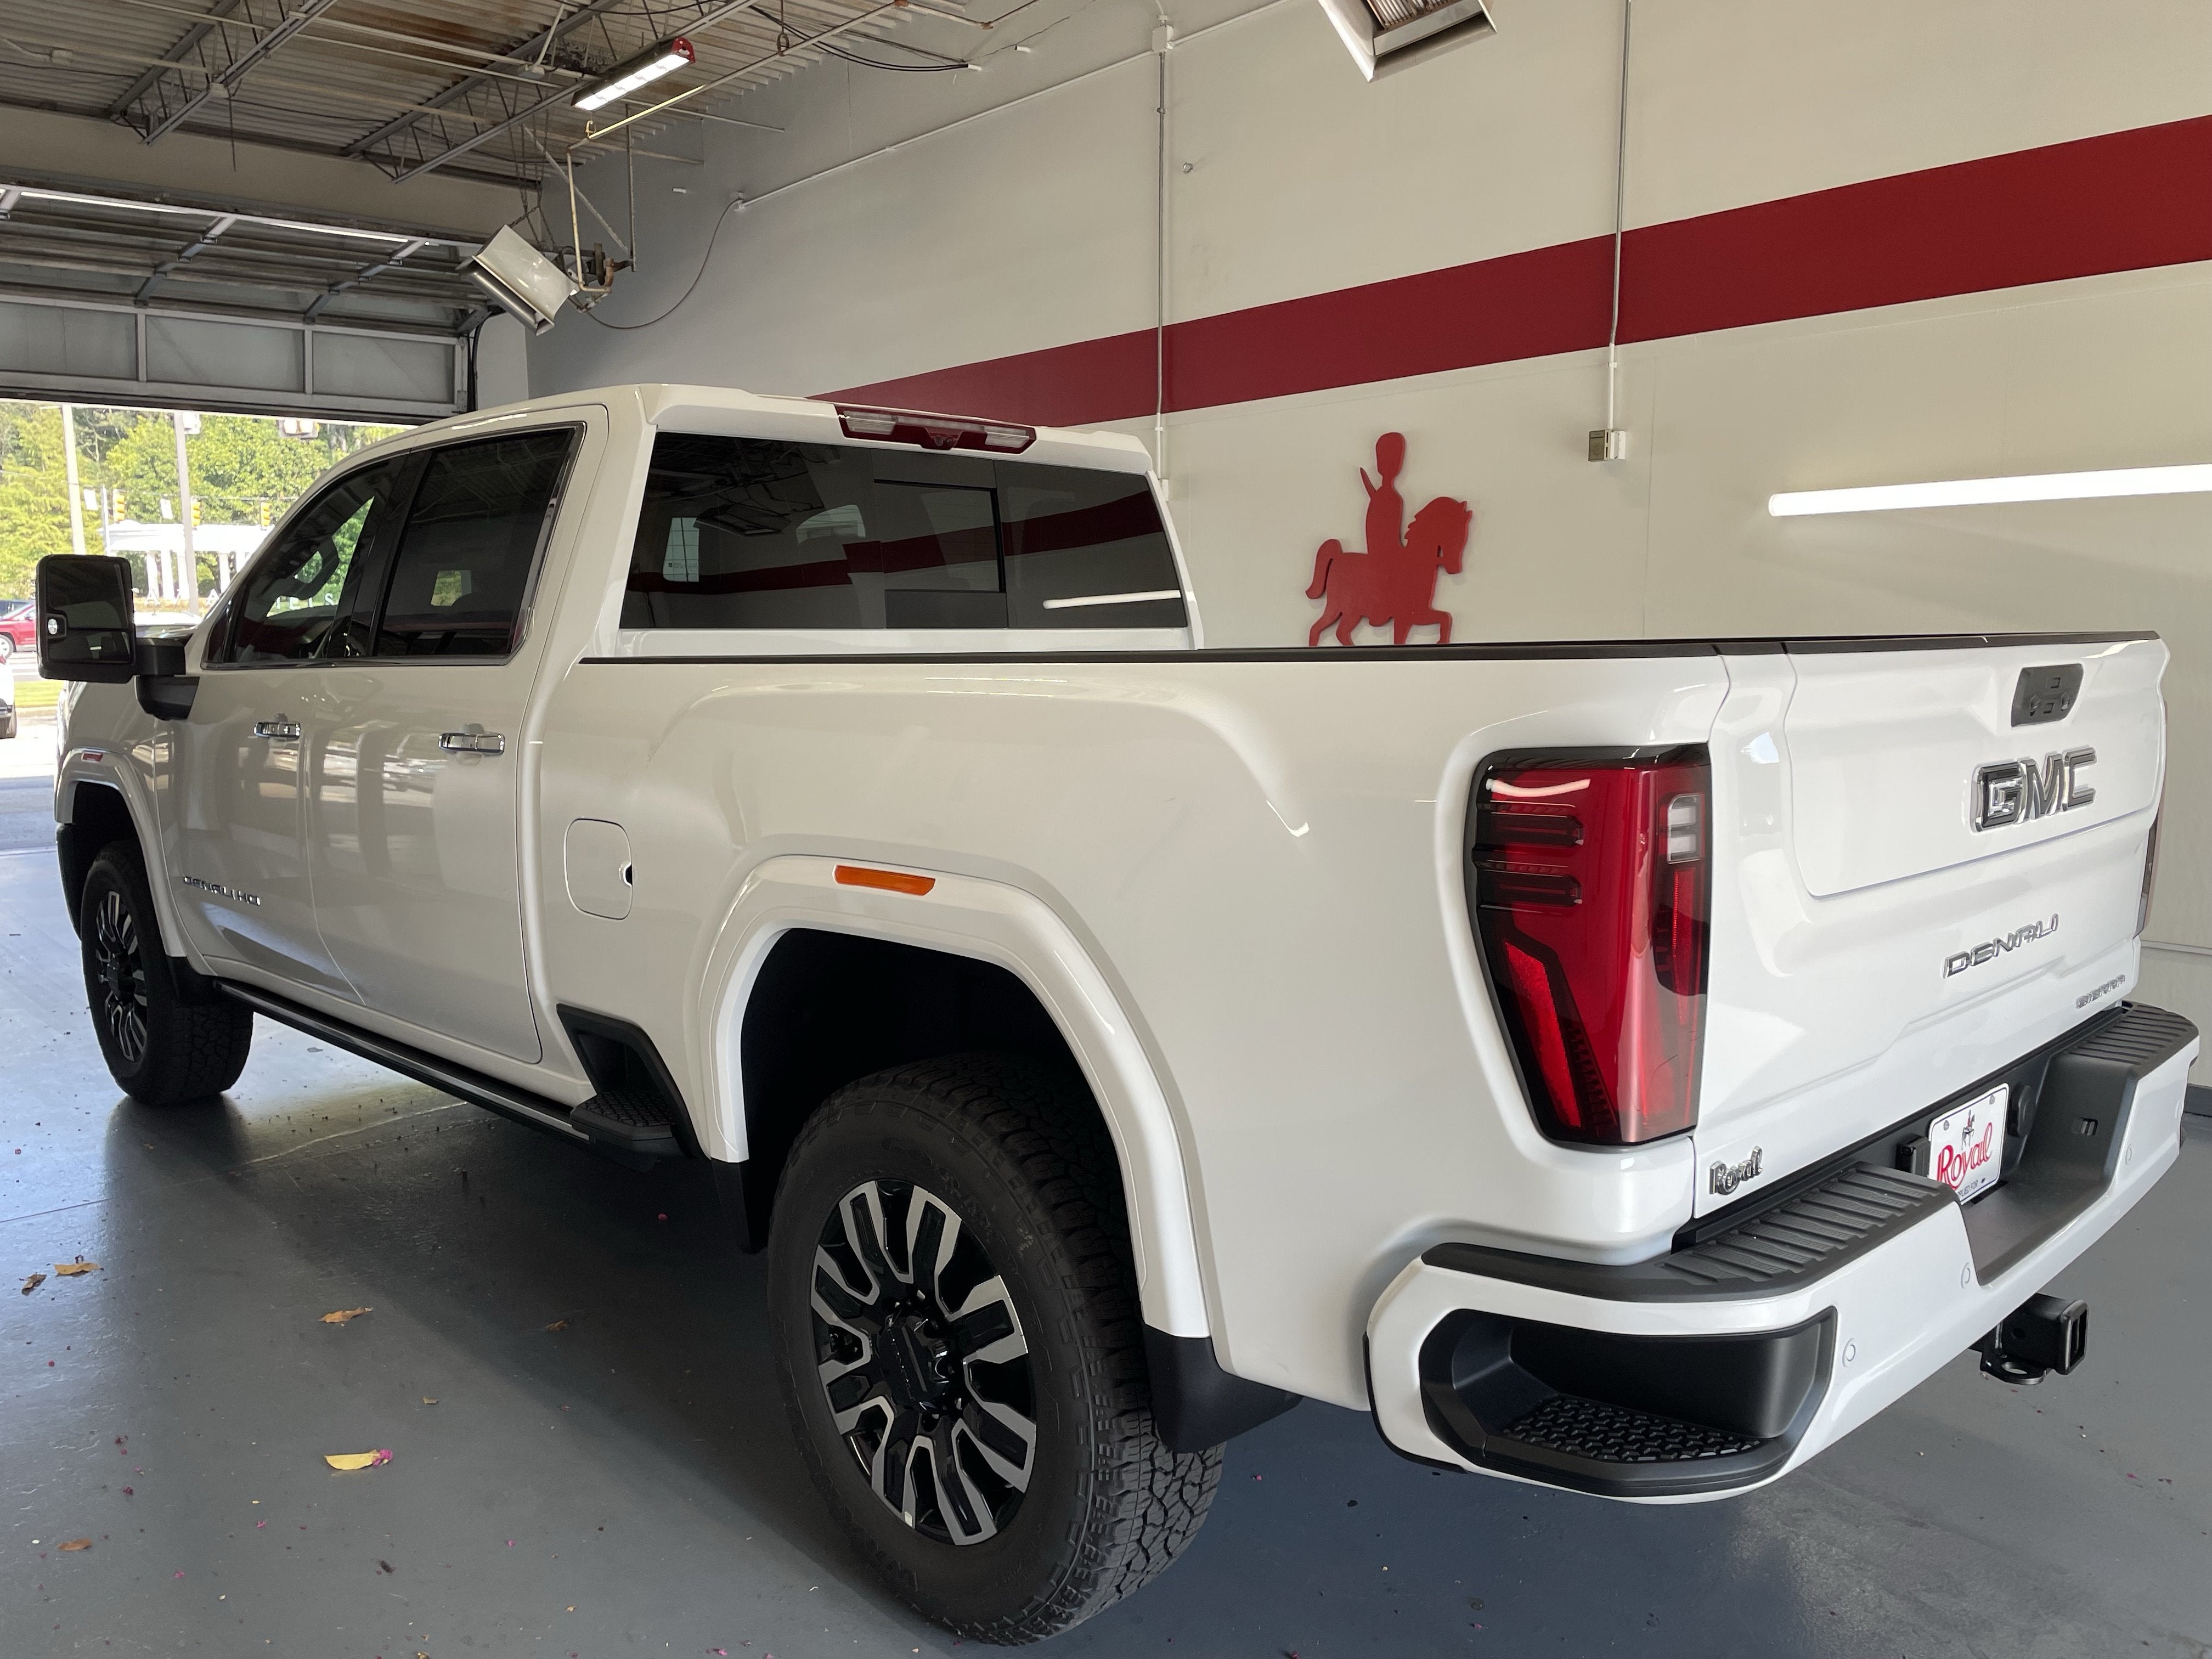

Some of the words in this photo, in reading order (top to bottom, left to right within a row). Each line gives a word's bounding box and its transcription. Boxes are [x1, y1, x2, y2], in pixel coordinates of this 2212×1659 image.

[1971, 745, 2097, 832] GMC
[184, 877, 236, 901] DENALI
[238, 890, 261, 906] HD
[1942, 913, 2058, 979] DENALI
[1709, 1146, 1763, 1195] Royal
[1937, 1122, 1993, 1190] Royal
